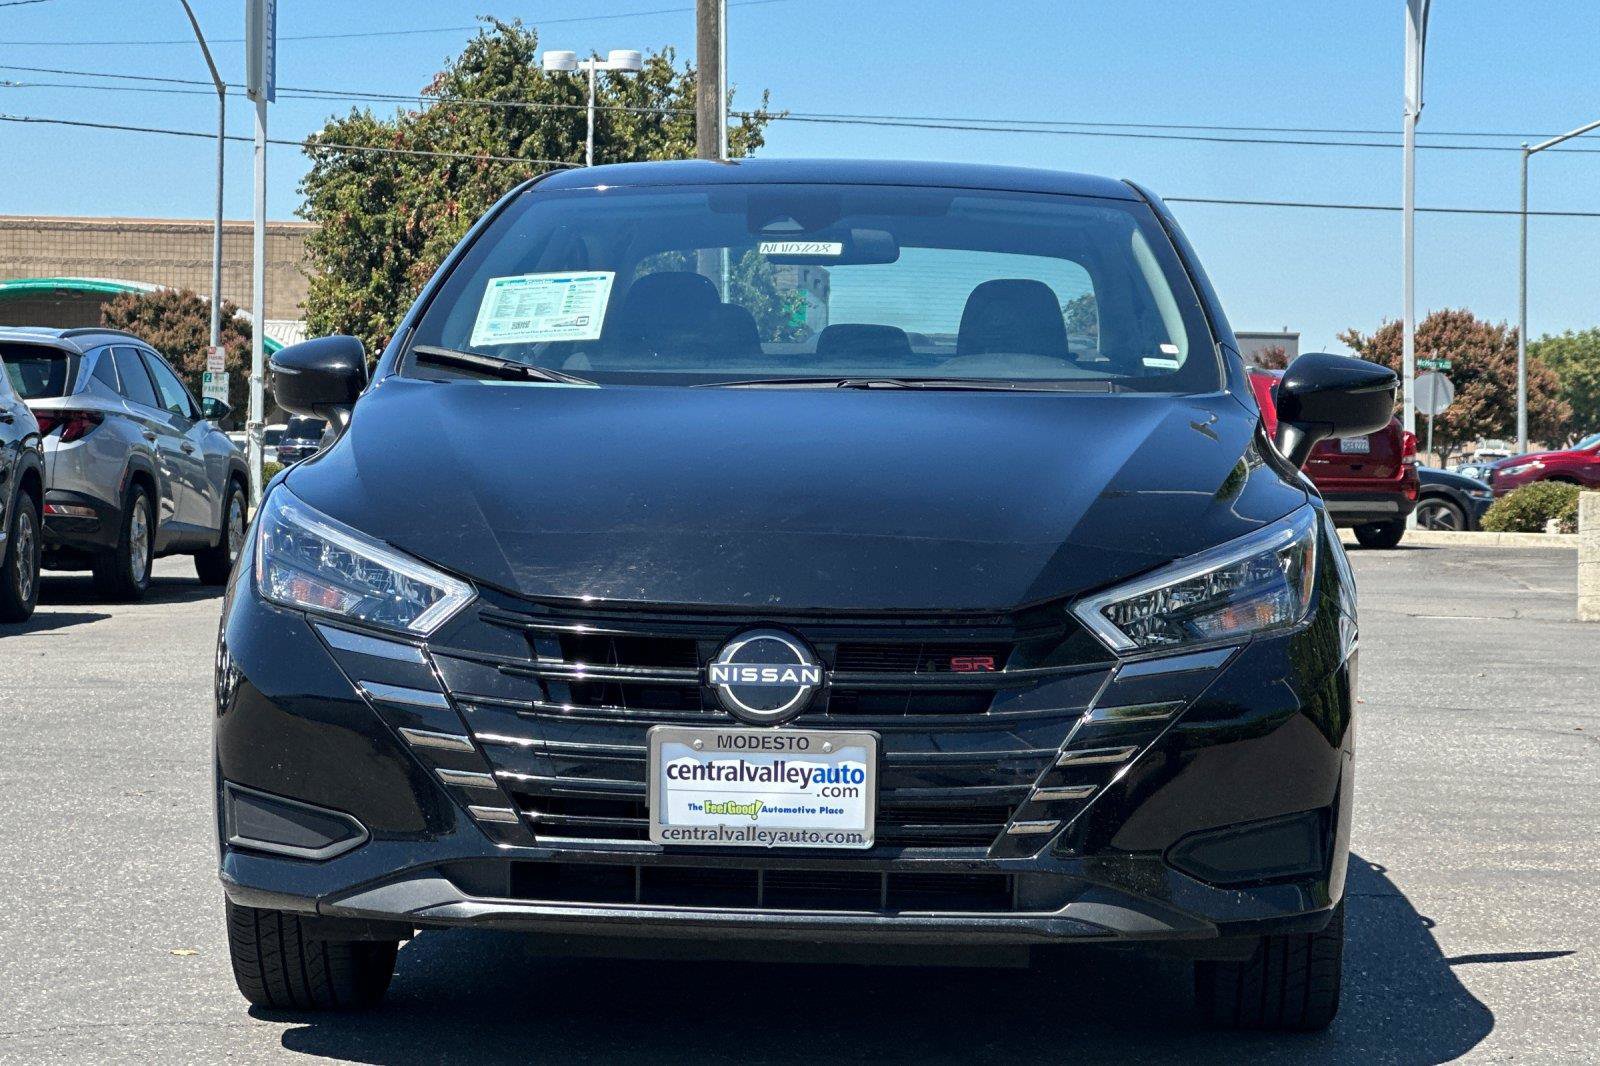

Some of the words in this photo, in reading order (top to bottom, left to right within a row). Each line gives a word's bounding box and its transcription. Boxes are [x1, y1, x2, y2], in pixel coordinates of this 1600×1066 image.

[950, 656, 995, 672] SR
[712, 667, 820, 683] NISSAN
[717, 735, 810, 750] MODESTO
[688, 802, 703, 812] The
[761, 805, 817, 815] Automotive
[819, 806, 844, 815] Place
[661, 824, 863, 846] centralvalleyauto.com
